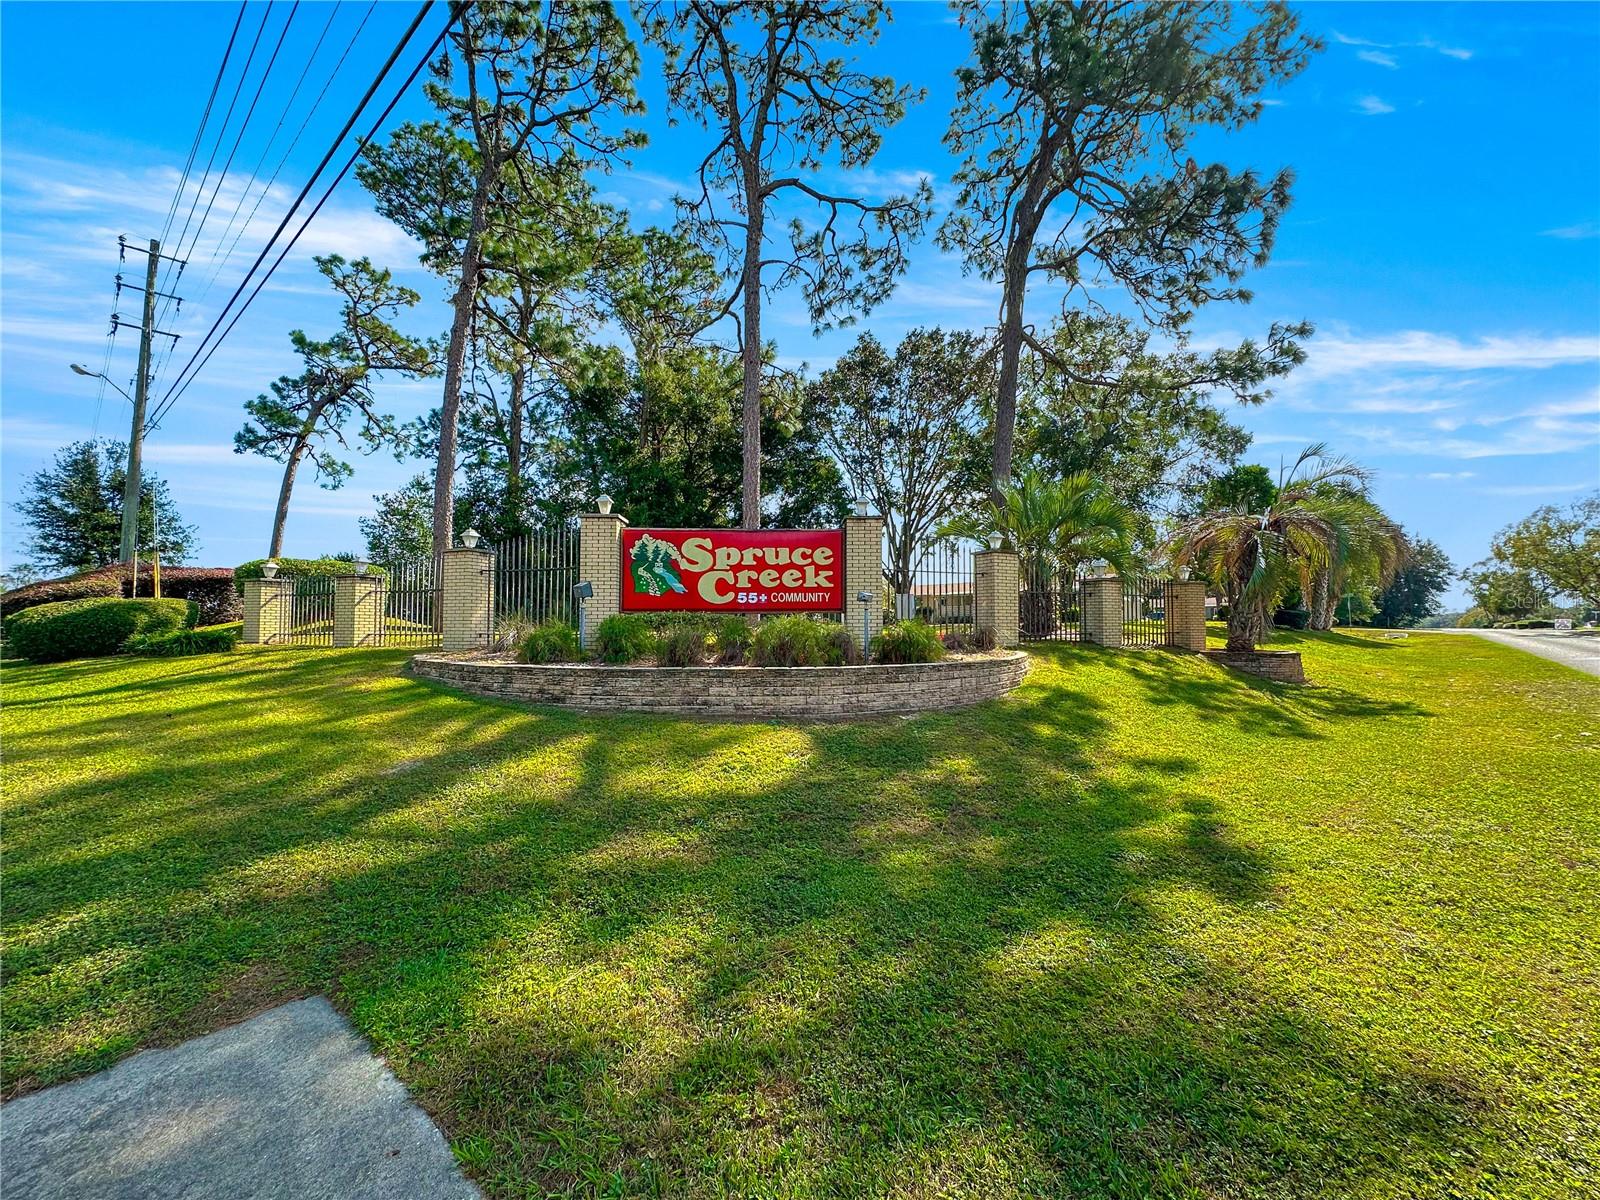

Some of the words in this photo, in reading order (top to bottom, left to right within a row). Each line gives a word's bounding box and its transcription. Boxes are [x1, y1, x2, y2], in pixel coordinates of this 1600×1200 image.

[681, 537, 834, 572] Spruce
[697, 566, 834, 604] Creek
[737, 592, 767, 603] 55+
[770, 592, 831, 602] COMMUNITY
